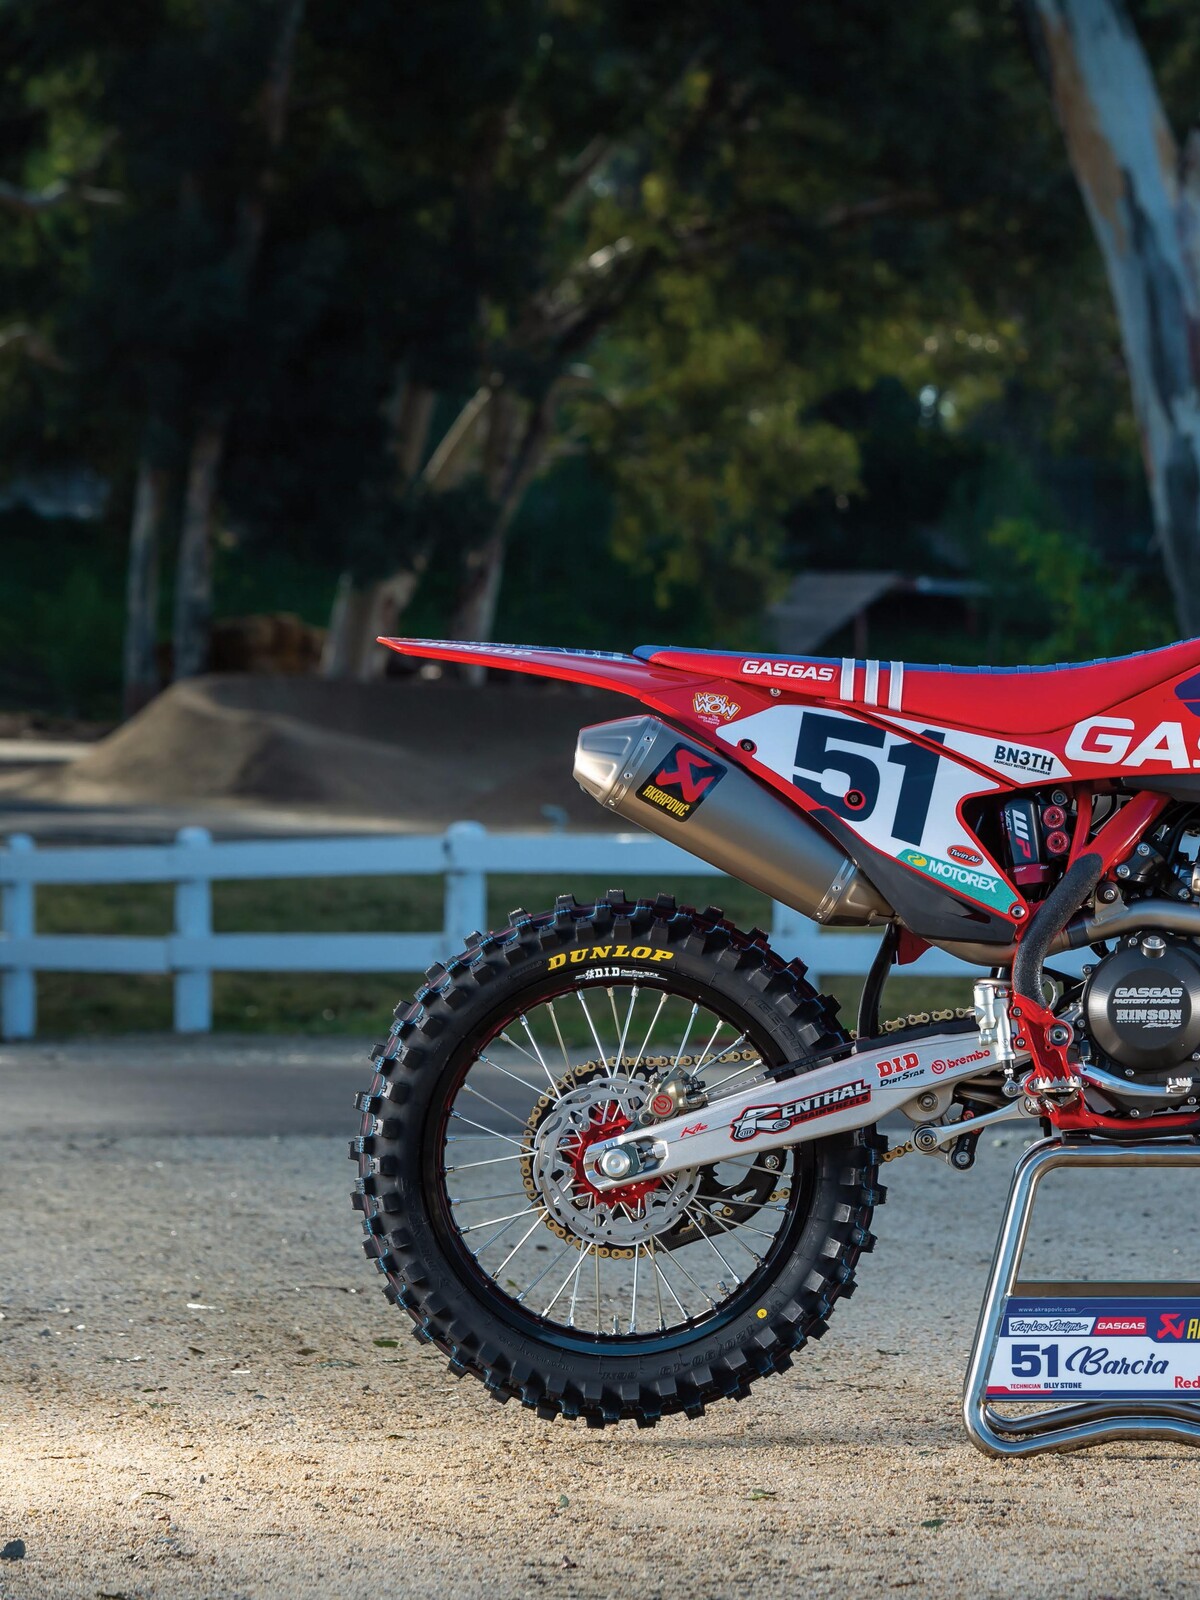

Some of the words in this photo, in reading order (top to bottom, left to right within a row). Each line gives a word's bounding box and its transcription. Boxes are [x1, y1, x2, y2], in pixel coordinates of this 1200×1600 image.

[742, 660, 834, 681] GASGAS
[994, 744, 1056, 772] BN3TH
[793, 712, 945, 847] 51
[950, 848, 968, 859] Twin
[968, 855, 981, 863] Air
[928, 860, 999, 893] MOTOREX
[547, 945, 674, 971] DUNLOP
[1114, 987, 1183, 998] GASGAS
[1116, 1009, 1182, 1020] HINSON
[876, 1052, 919, 1077] D.I.D
[946, 1049, 991, 1069] brembo
[1010, 1320, 1031, 1333] Troy
[1031, 1320, 1049, 1331] Lee
[1097, 1322, 1145, 1330] GASGAS
[1011, 1344, 1059, 1377] 51
[1065, 1346, 1169, 1375] Barcia
[1174, 1376, 1200, 1388] Red
